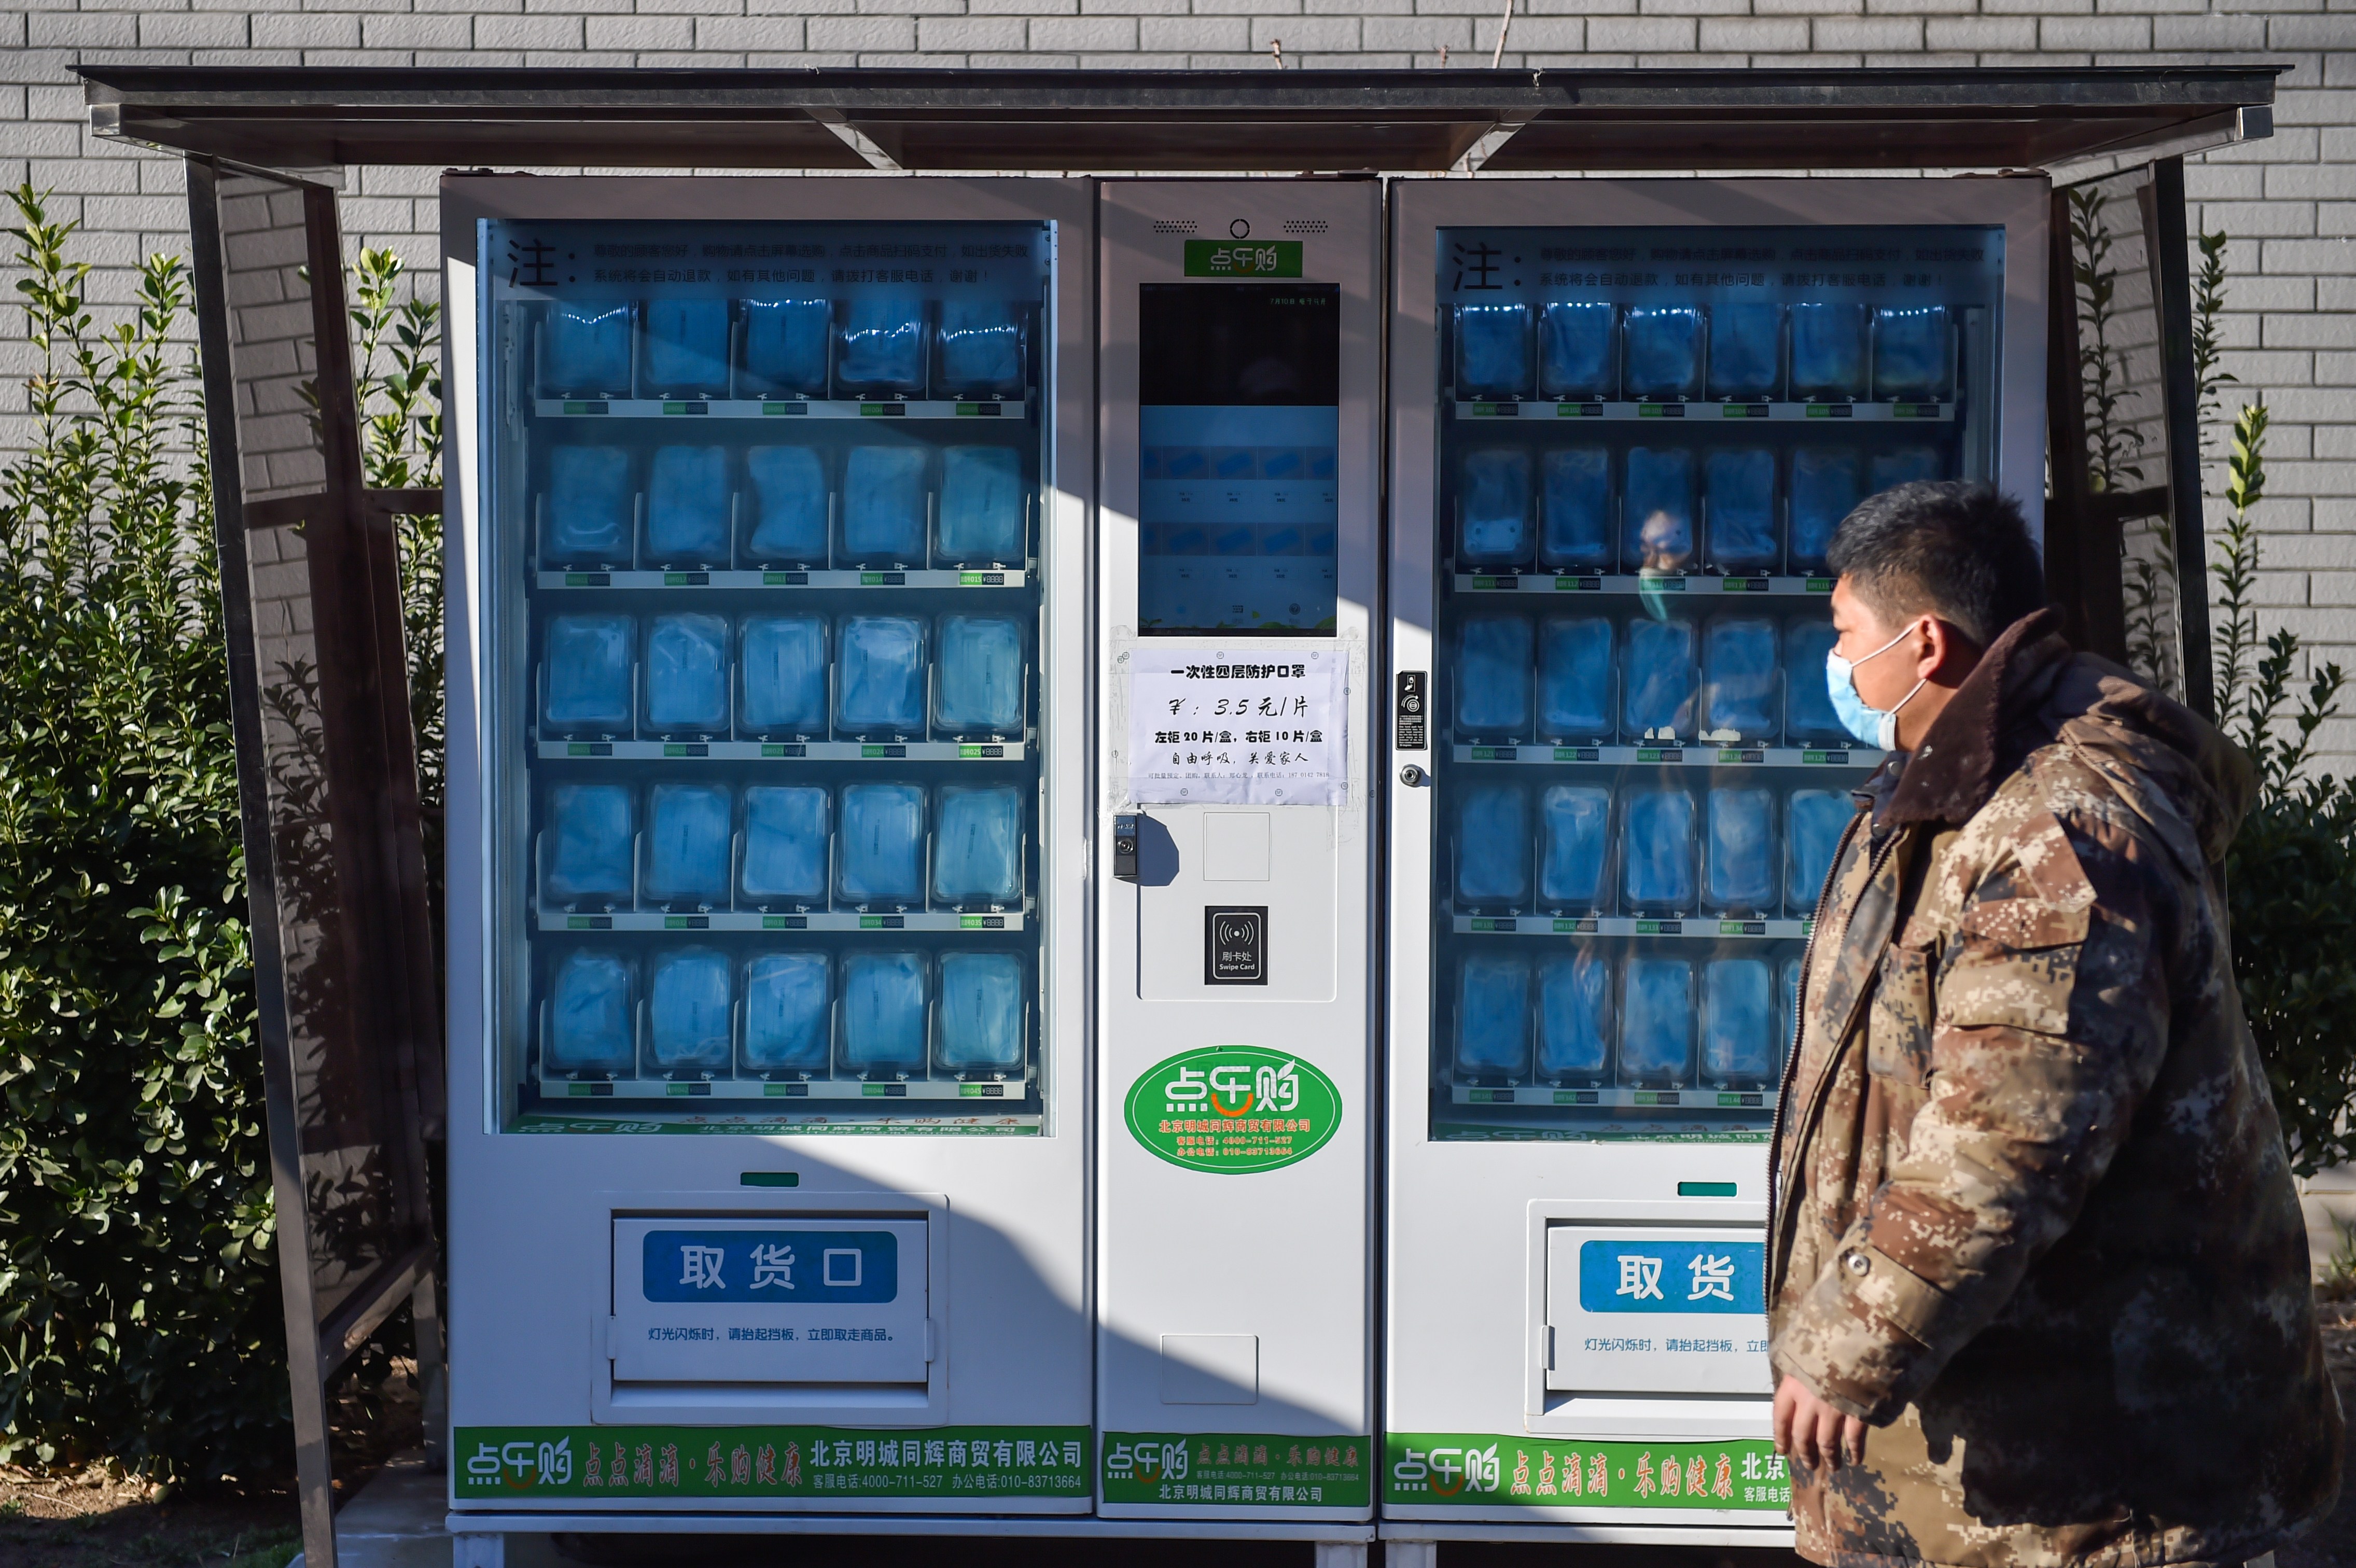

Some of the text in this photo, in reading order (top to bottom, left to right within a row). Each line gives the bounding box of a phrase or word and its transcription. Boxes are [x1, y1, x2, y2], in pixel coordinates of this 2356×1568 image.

[508, 238, 576, 288] 注：
[1453, 242, 1521, 292] 注：
[1170, 664, 1306, 679] 一次性四层防护口罩
[1221, 951, 1252, 962] 刷卡处
[1159, 1119, 1310, 1132] 北京明城同辉商贸有限公司
[679, 1243, 862, 1290] 取货口
[648, 1327, 894, 1342] 灯光闪烁时，请抬起挡板，立即取走商品。
[810, 1440, 1082, 1469] 北京明城同辉商贸有限公司
[1159, 1485, 1322, 1502] 北京明城同辉商贸有限公司
